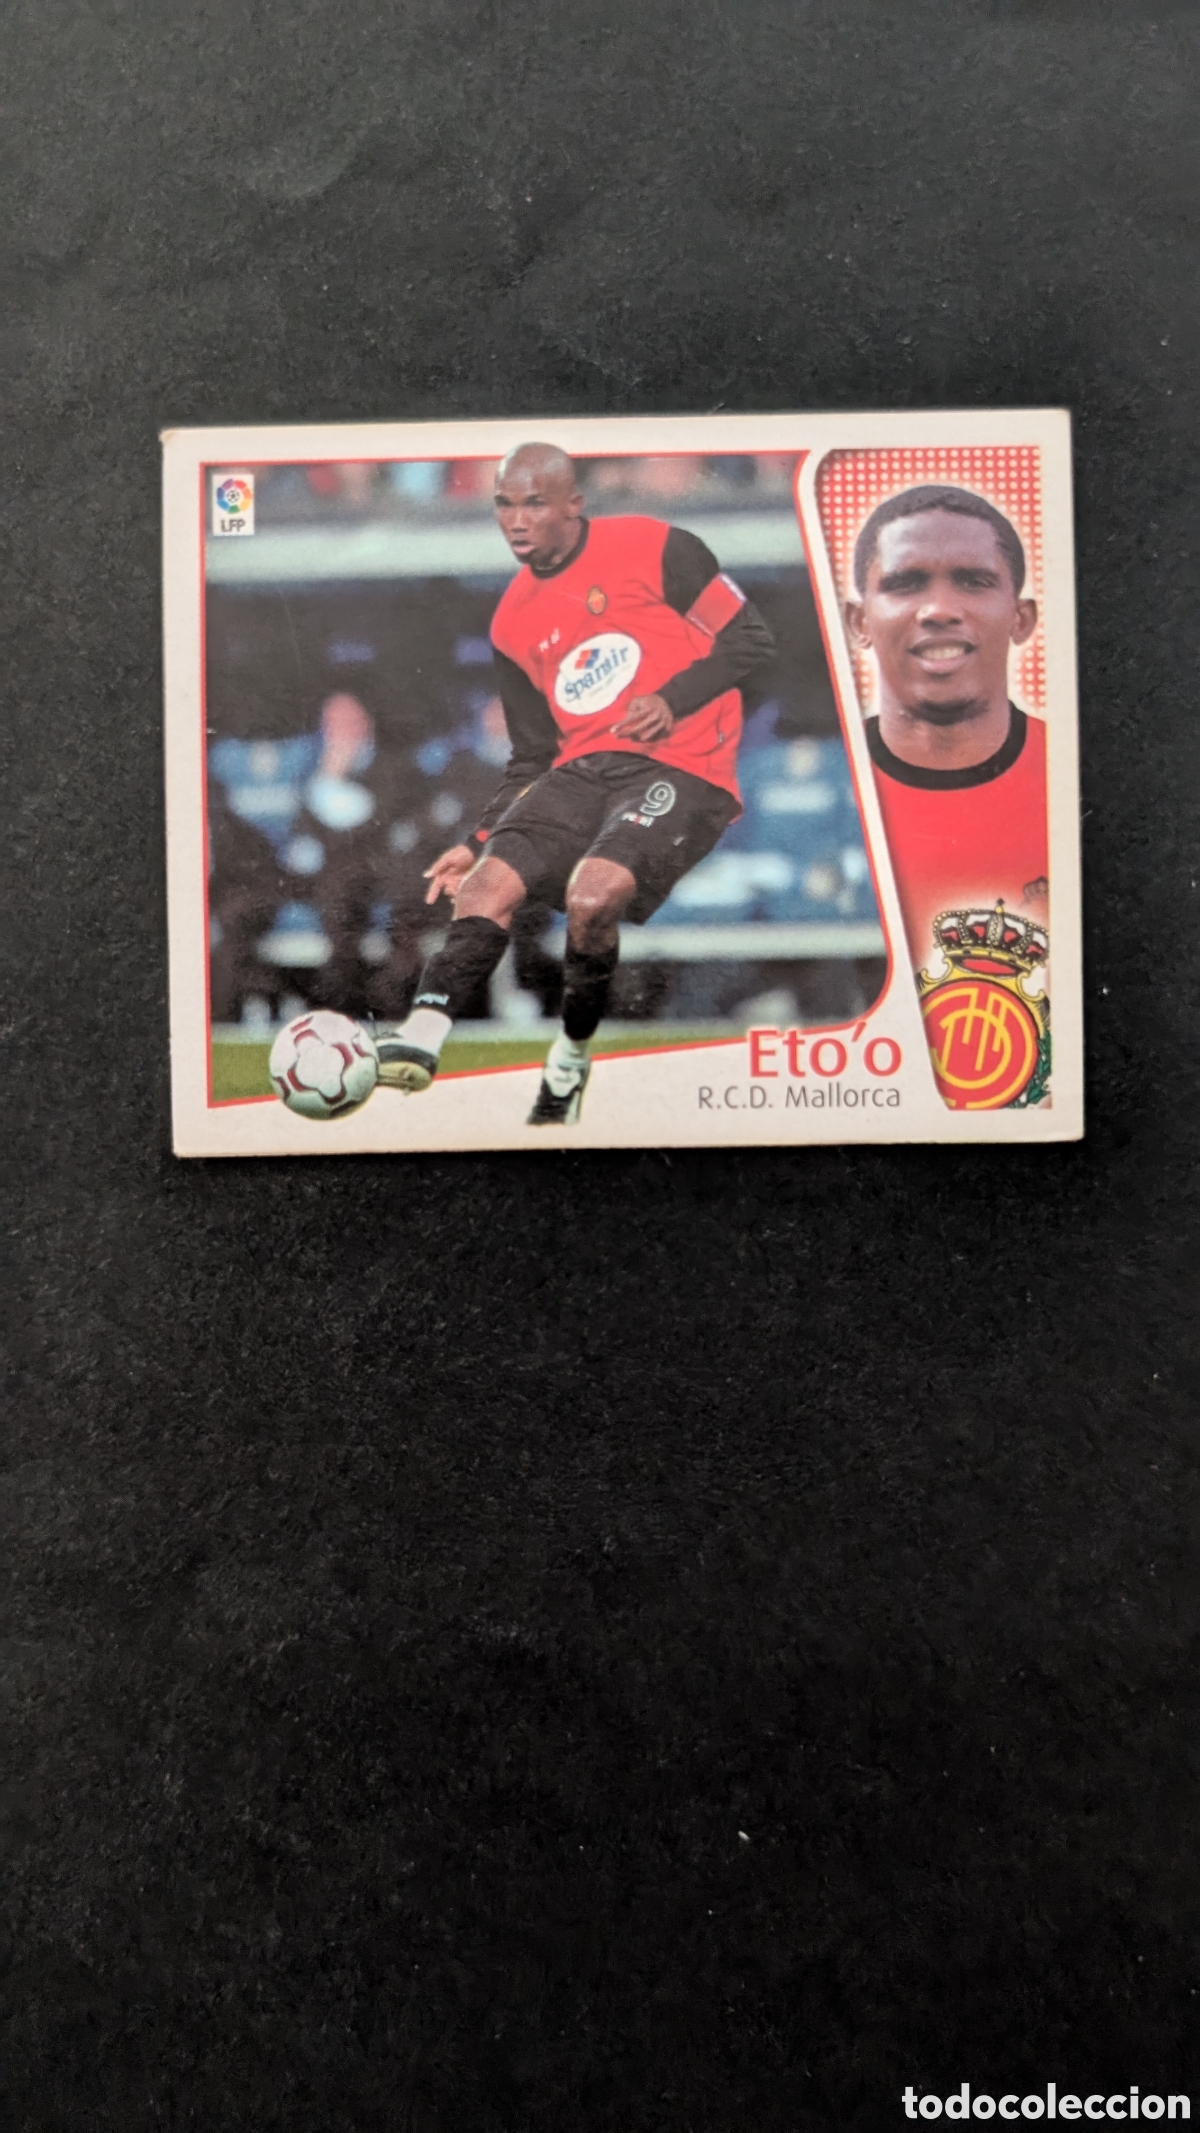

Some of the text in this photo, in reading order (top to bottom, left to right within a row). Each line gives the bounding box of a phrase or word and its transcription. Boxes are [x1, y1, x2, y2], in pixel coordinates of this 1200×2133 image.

[220, 519, 246, 533] LFP
[640, 781, 676, 816] 9
[698, 1082, 900, 1109] R.C.D. Mallorca
